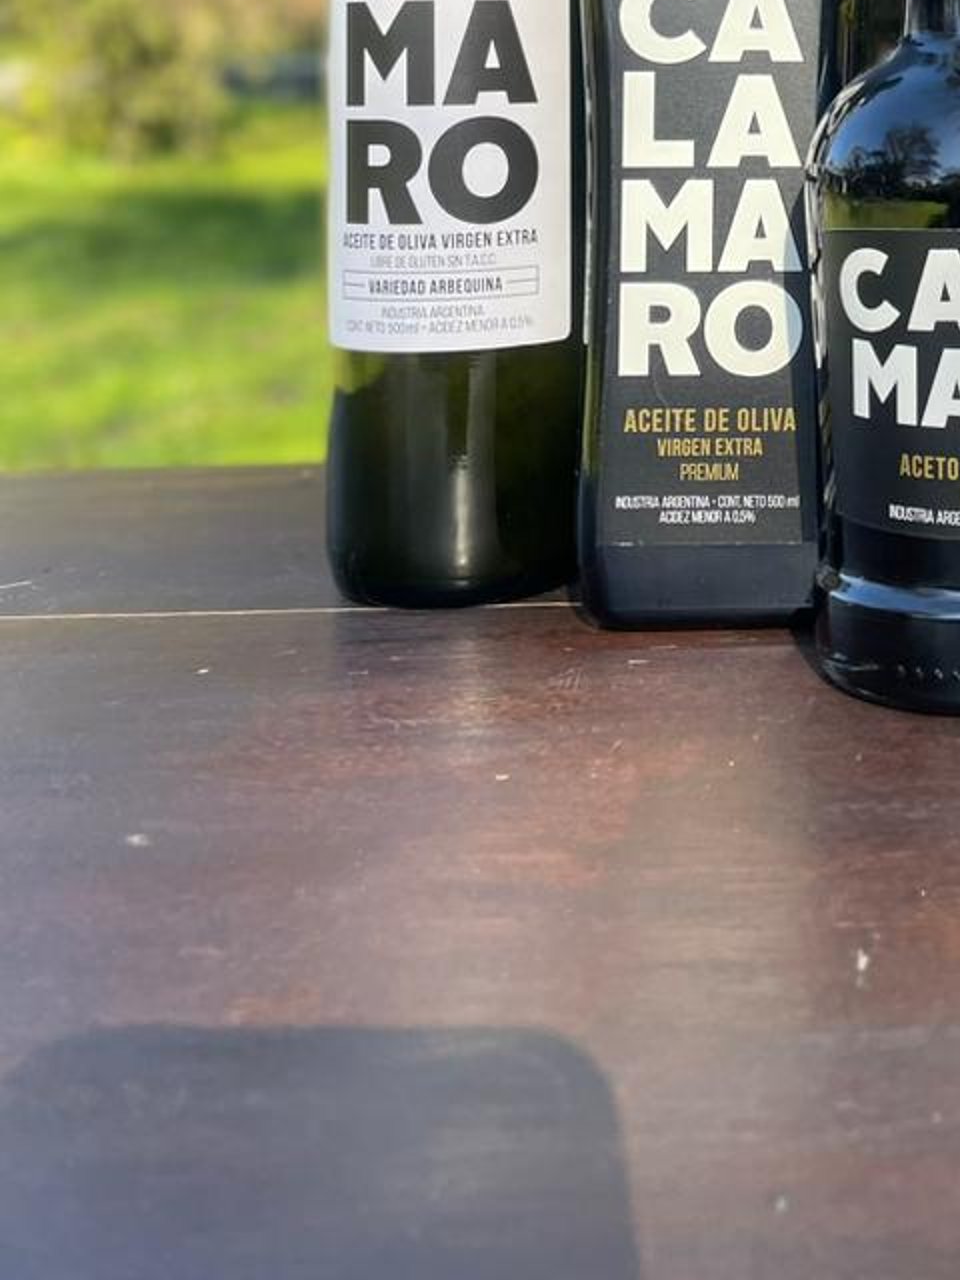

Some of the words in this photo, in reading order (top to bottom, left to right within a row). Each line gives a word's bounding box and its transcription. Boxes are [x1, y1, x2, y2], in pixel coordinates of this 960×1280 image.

[346, 0, 539, 107] MA
[621, 71, 802, 168] LA
[346, 116, 540, 225] RO
[620, 179, 803, 273] MA
[343, 231, 376, 250] ACEITE
[379, 233, 395, 251] DE
[398, 232, 437, 250] OLIVA
[441, 231, 492, 250] VIRGEN
[496, 228, 538, 247] EXTRA
[368, 278, 426, 296] VARIEDAD
[430, 276, 503, 295] ARBEQUINA
[618, 280, 804, 377] RO
[624, 407, 697, 433] ACEITE
[704, 407, 730, 433] DE
[737, 407, 797, 433] OLIVA
[657, 437, 711, 457] VIRGEN
[715, 437, 763, 456] EXTRA
[679, 463, 739, 481] PREMIUM
[900, 453, 959, 481] ACETO
[661, 495, 711, 509] ARGENTINA
[743, 495, 767, 509] NETO
[889, 503, 935, 525] INDUSTRIA
[691, 510, 723, 524] MENOR
